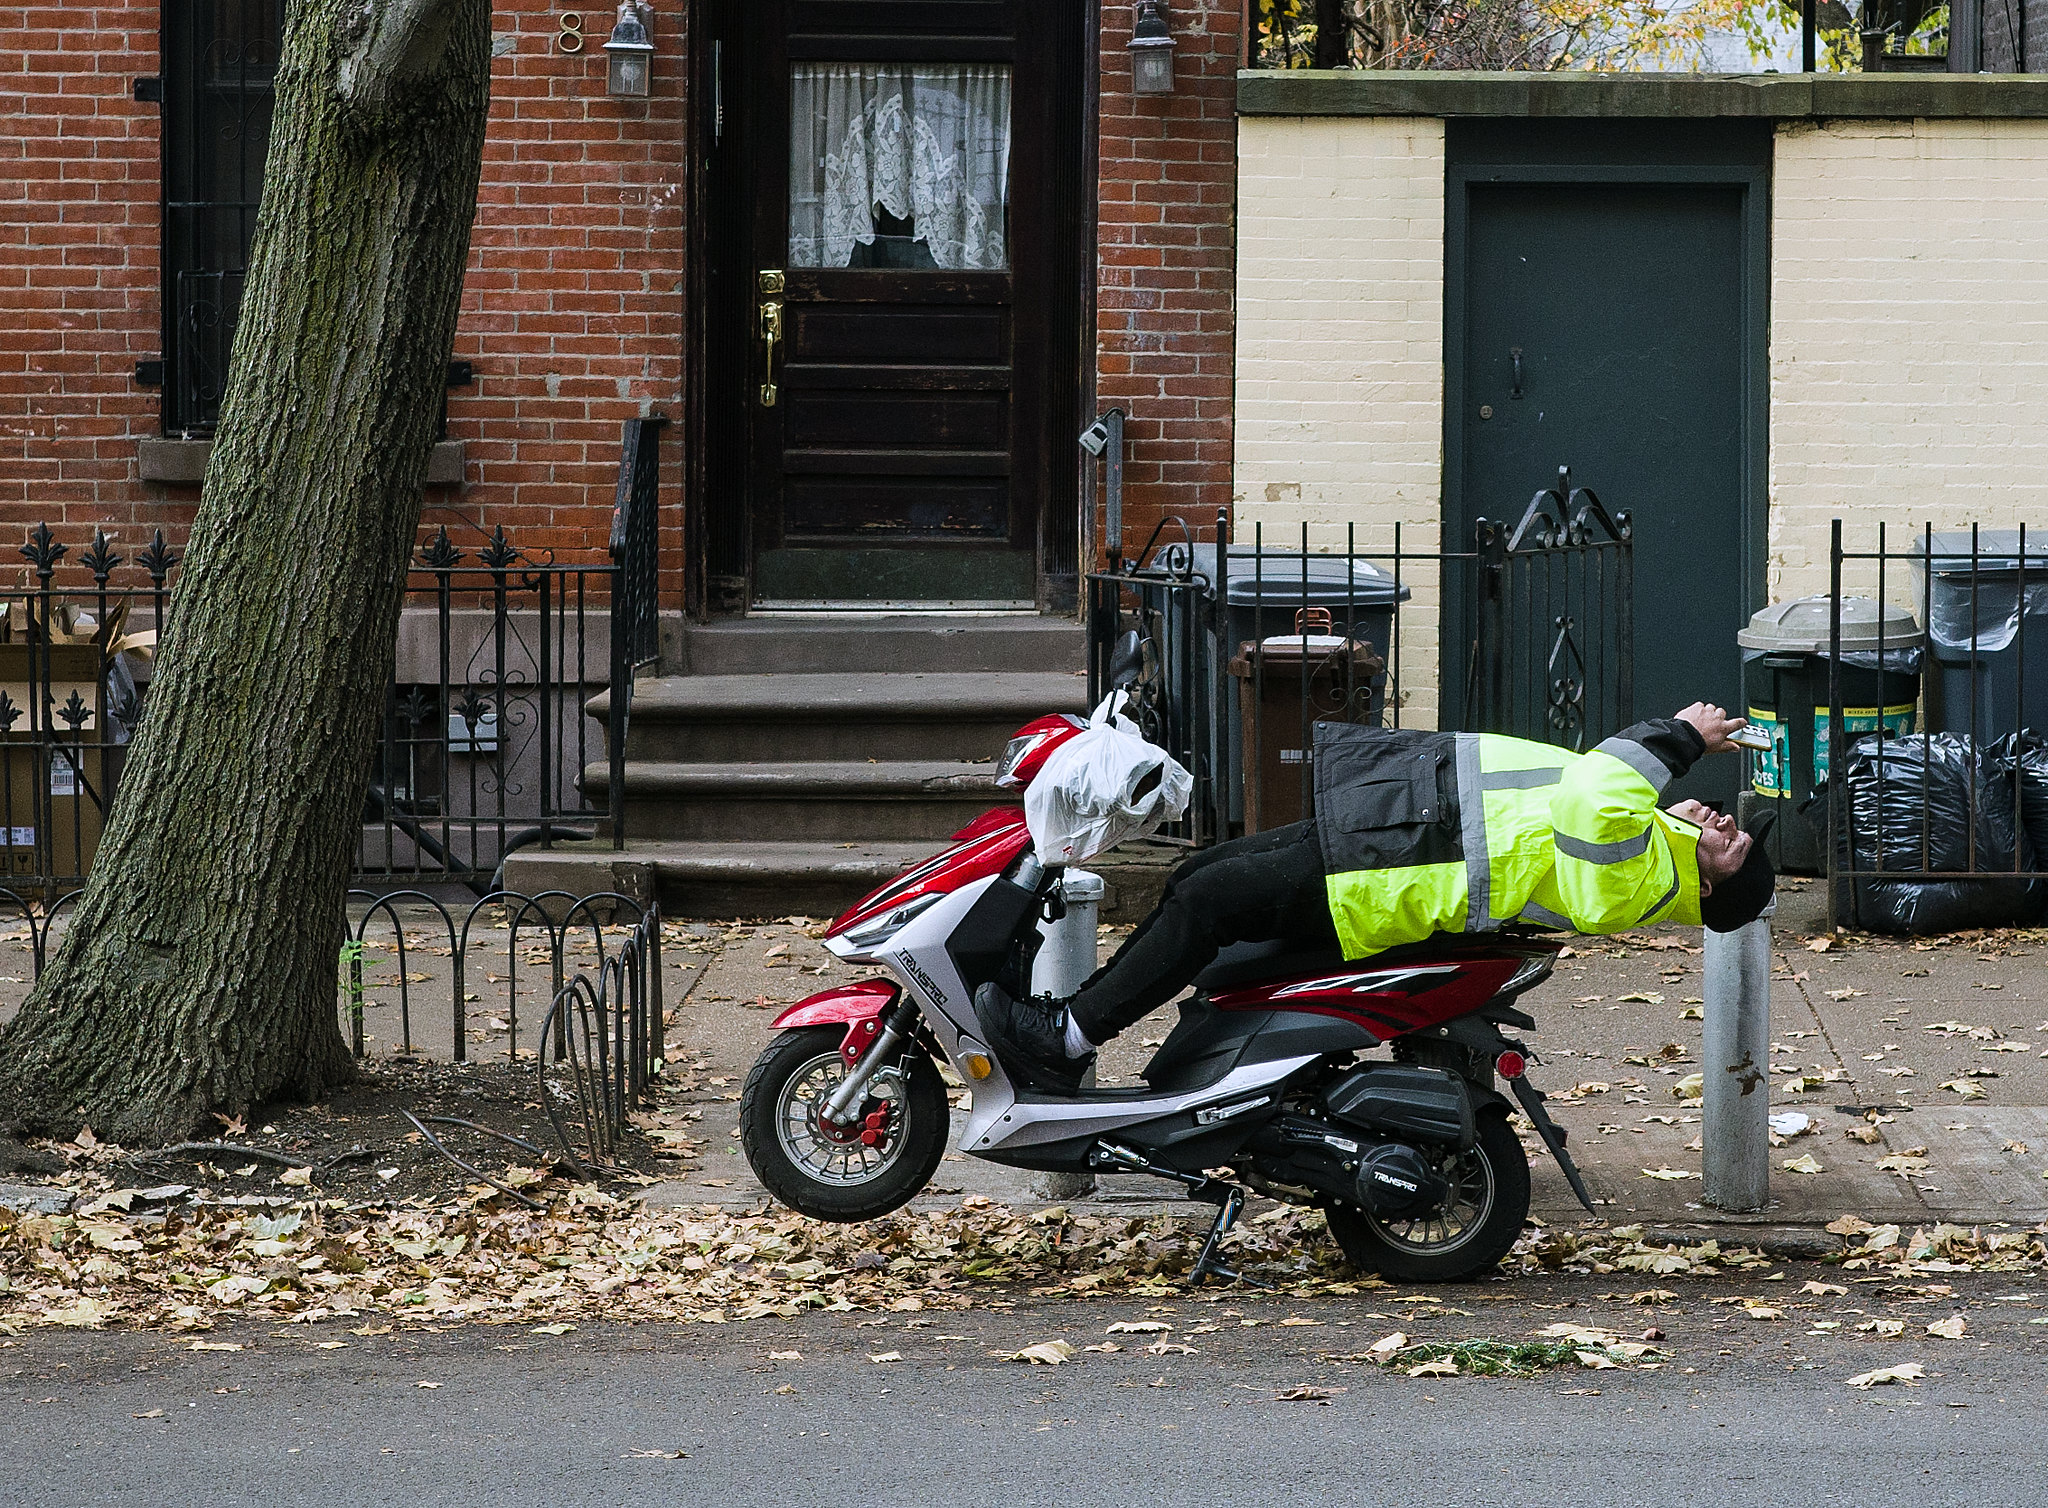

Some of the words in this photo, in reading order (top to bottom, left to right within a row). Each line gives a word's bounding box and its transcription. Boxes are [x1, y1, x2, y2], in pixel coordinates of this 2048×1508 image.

[558, 12, 584, 53] 8
[899, 947, 949, 1006] TRANSPRO
[1374, 1171, 1418, 1192] TRANSPRO
